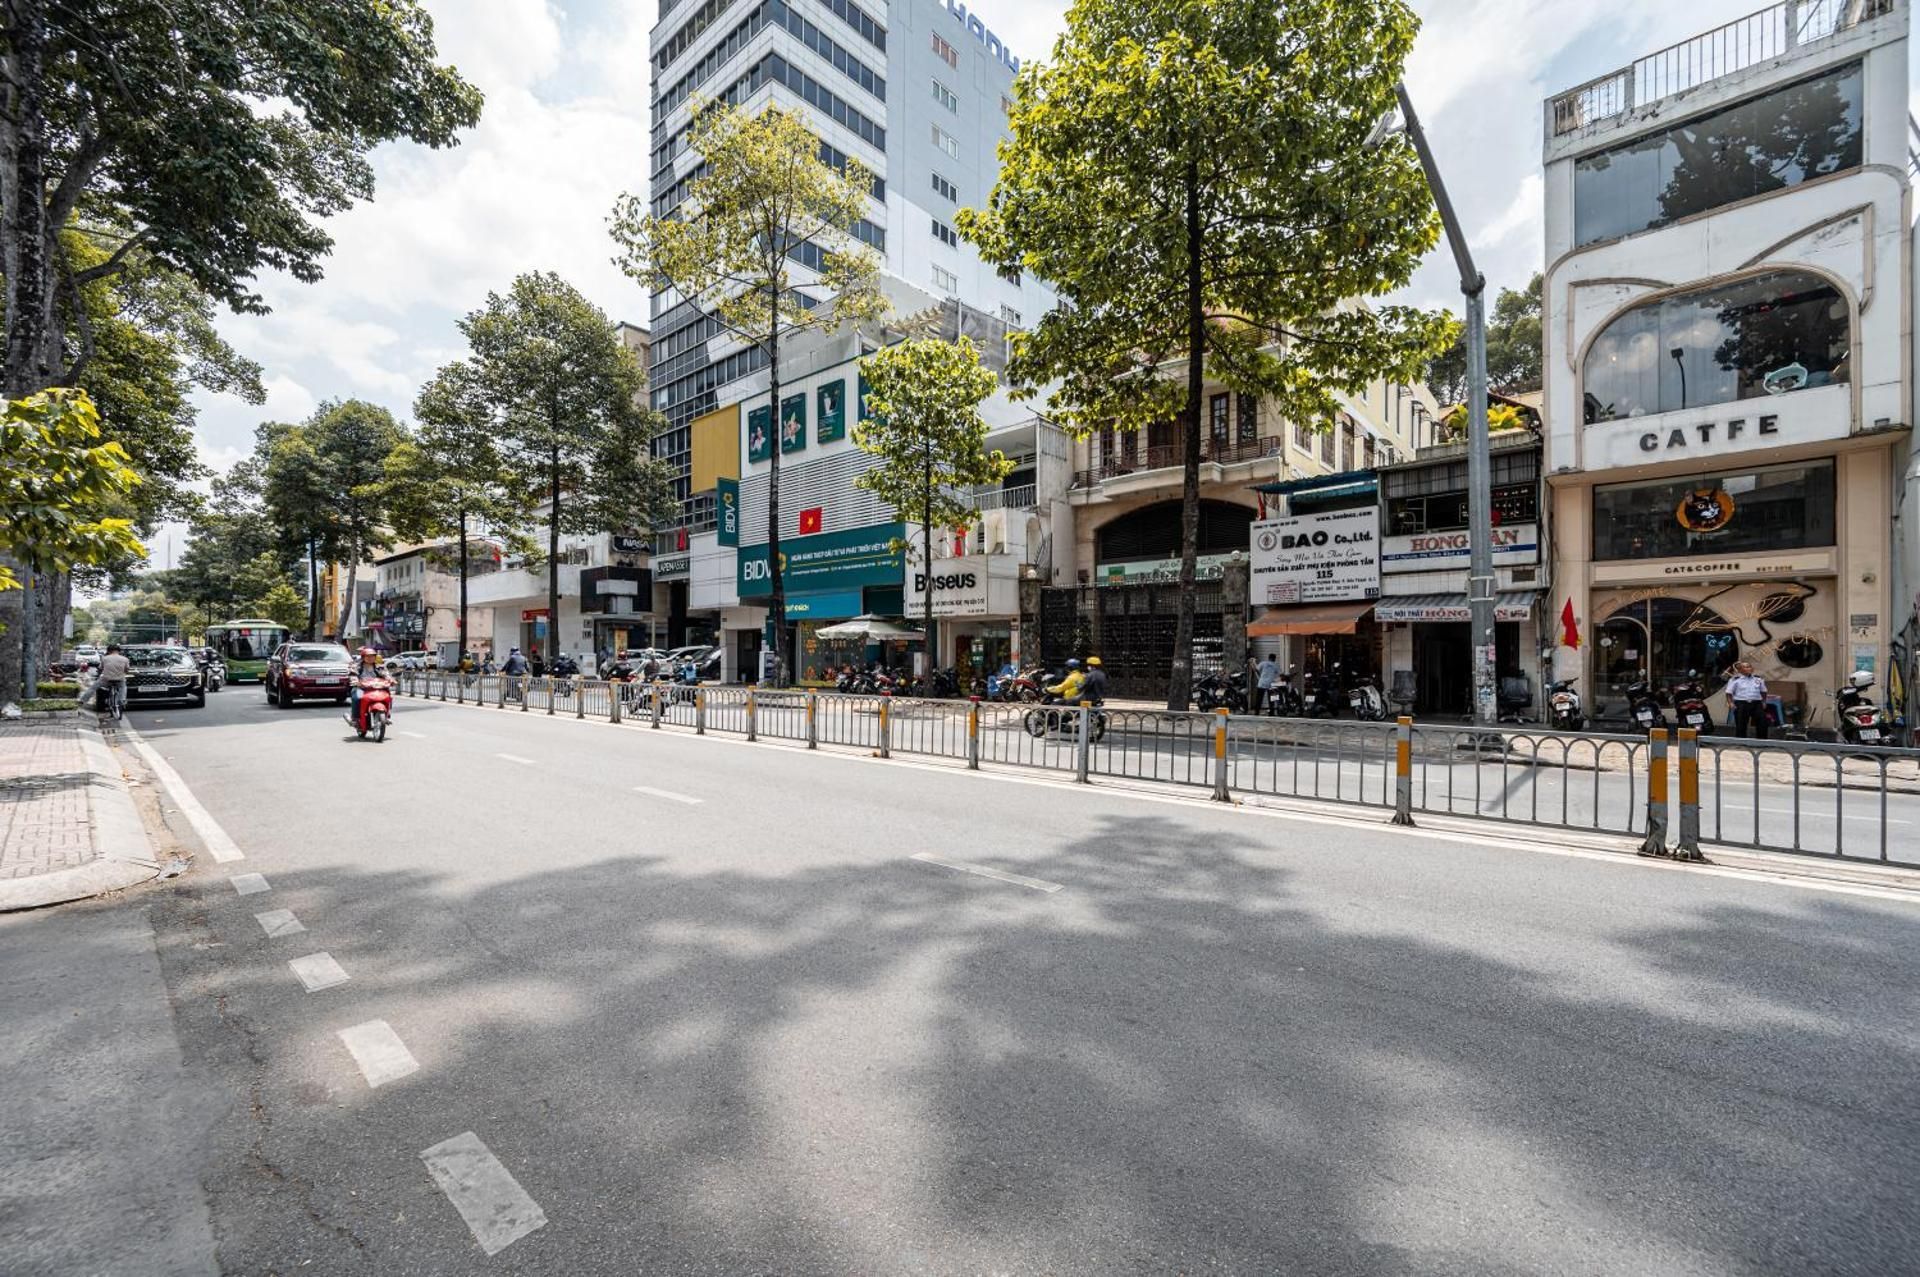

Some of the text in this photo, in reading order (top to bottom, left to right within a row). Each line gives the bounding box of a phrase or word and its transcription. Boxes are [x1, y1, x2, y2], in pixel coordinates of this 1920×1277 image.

[1638, 414, 1779, 452] CATFE
[724, 503, 736, 534] BIDV
[1281, 530, 1329, 549] BAO
[915, 572, 977, 593] Bseus
[1316, 570, 1334, 579] 115
